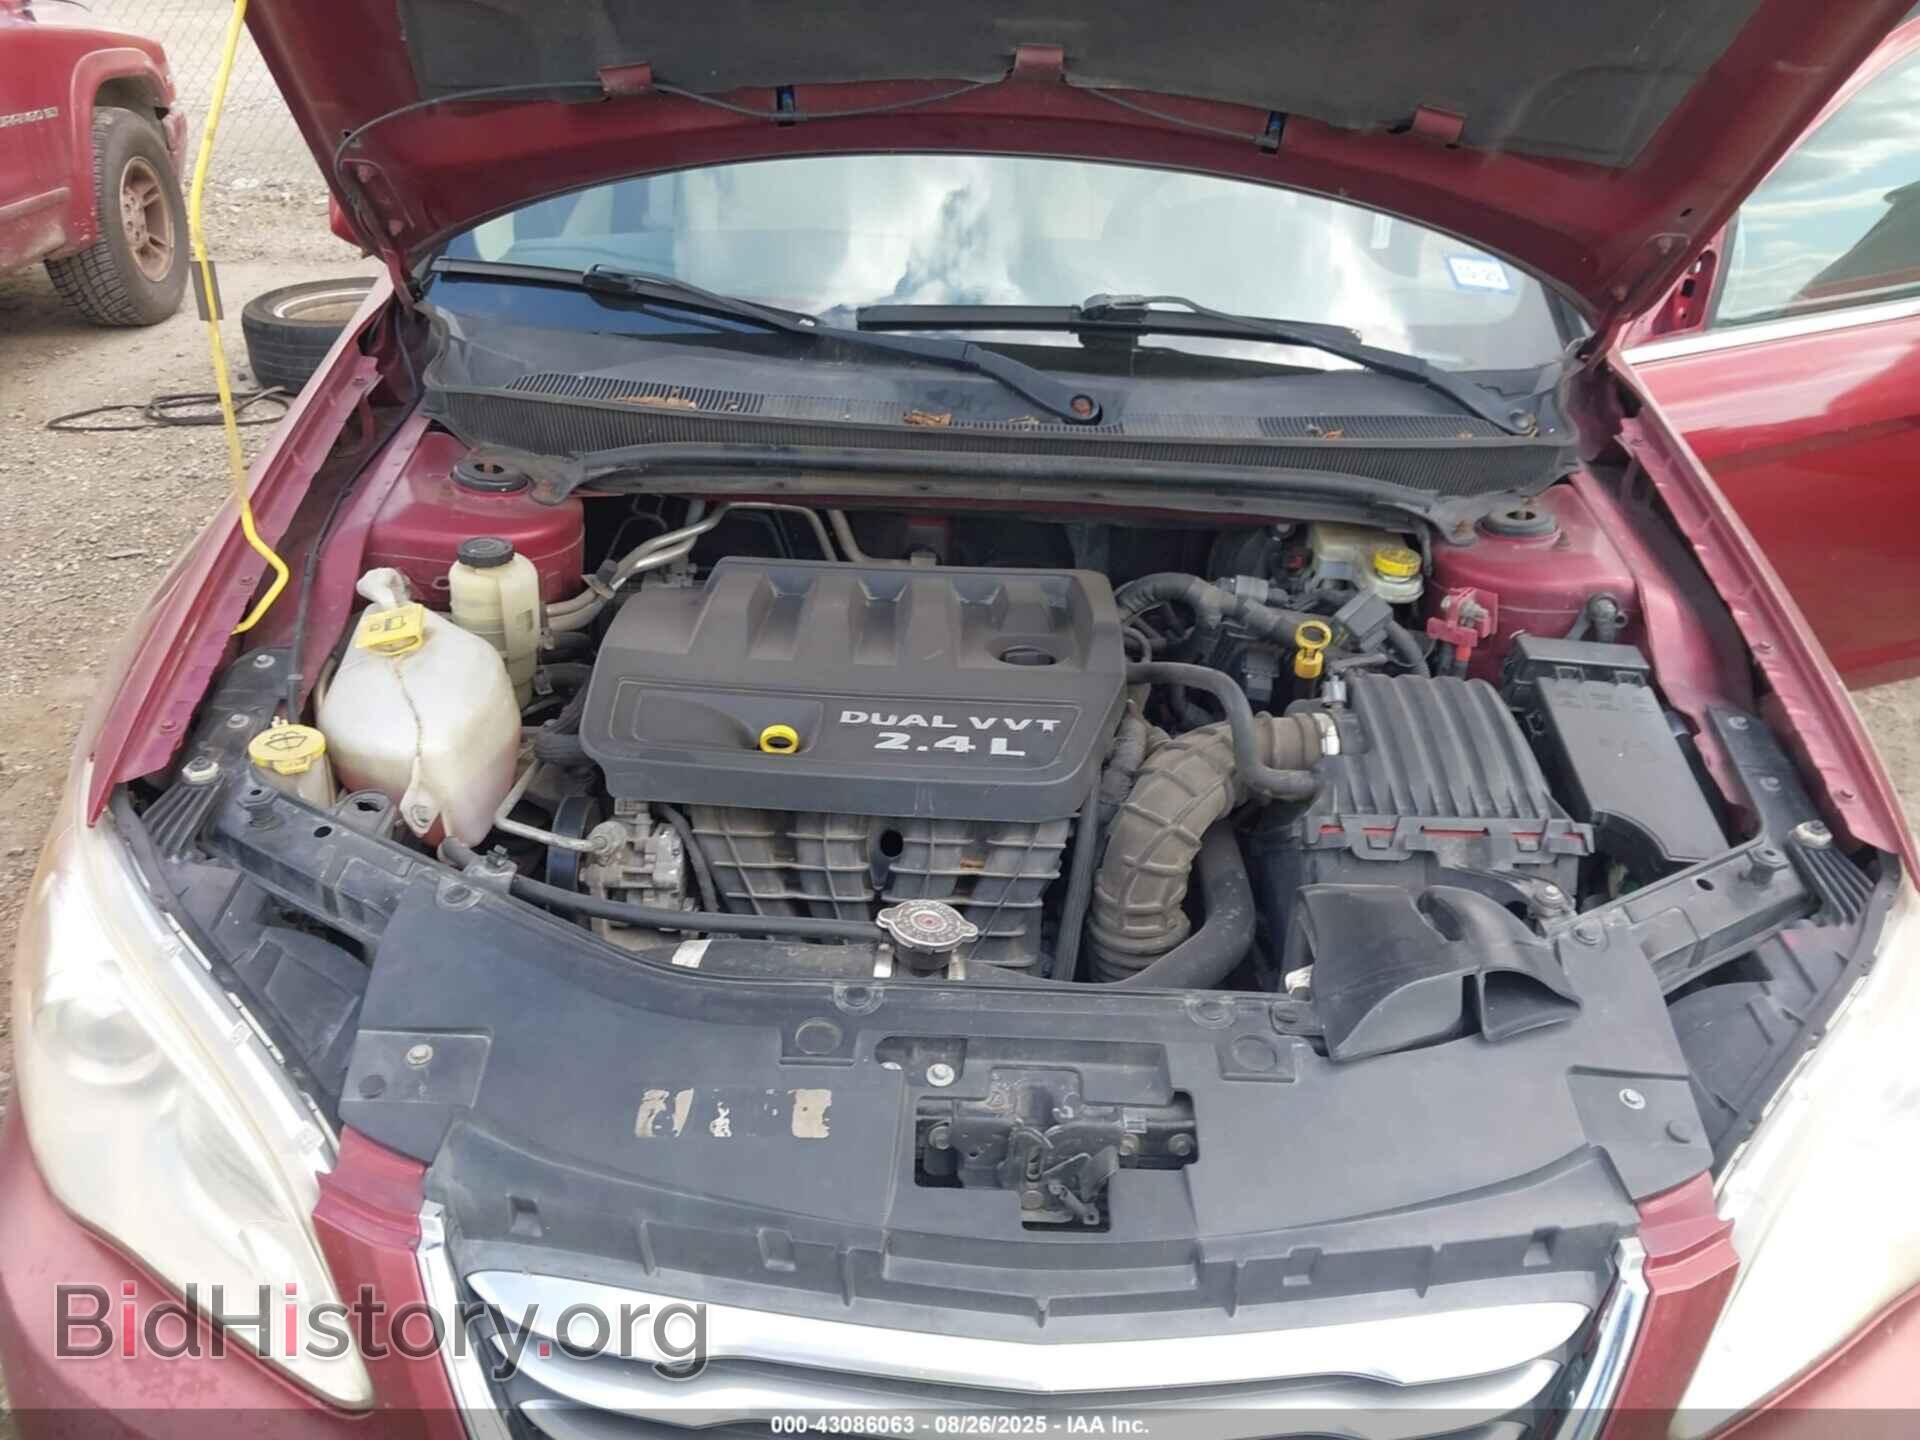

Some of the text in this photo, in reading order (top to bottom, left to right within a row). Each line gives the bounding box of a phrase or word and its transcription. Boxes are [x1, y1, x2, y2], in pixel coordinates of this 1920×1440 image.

[839, 710, 1062, 732] DUAL VVT
[873, 731, 977, 753] 2.4
